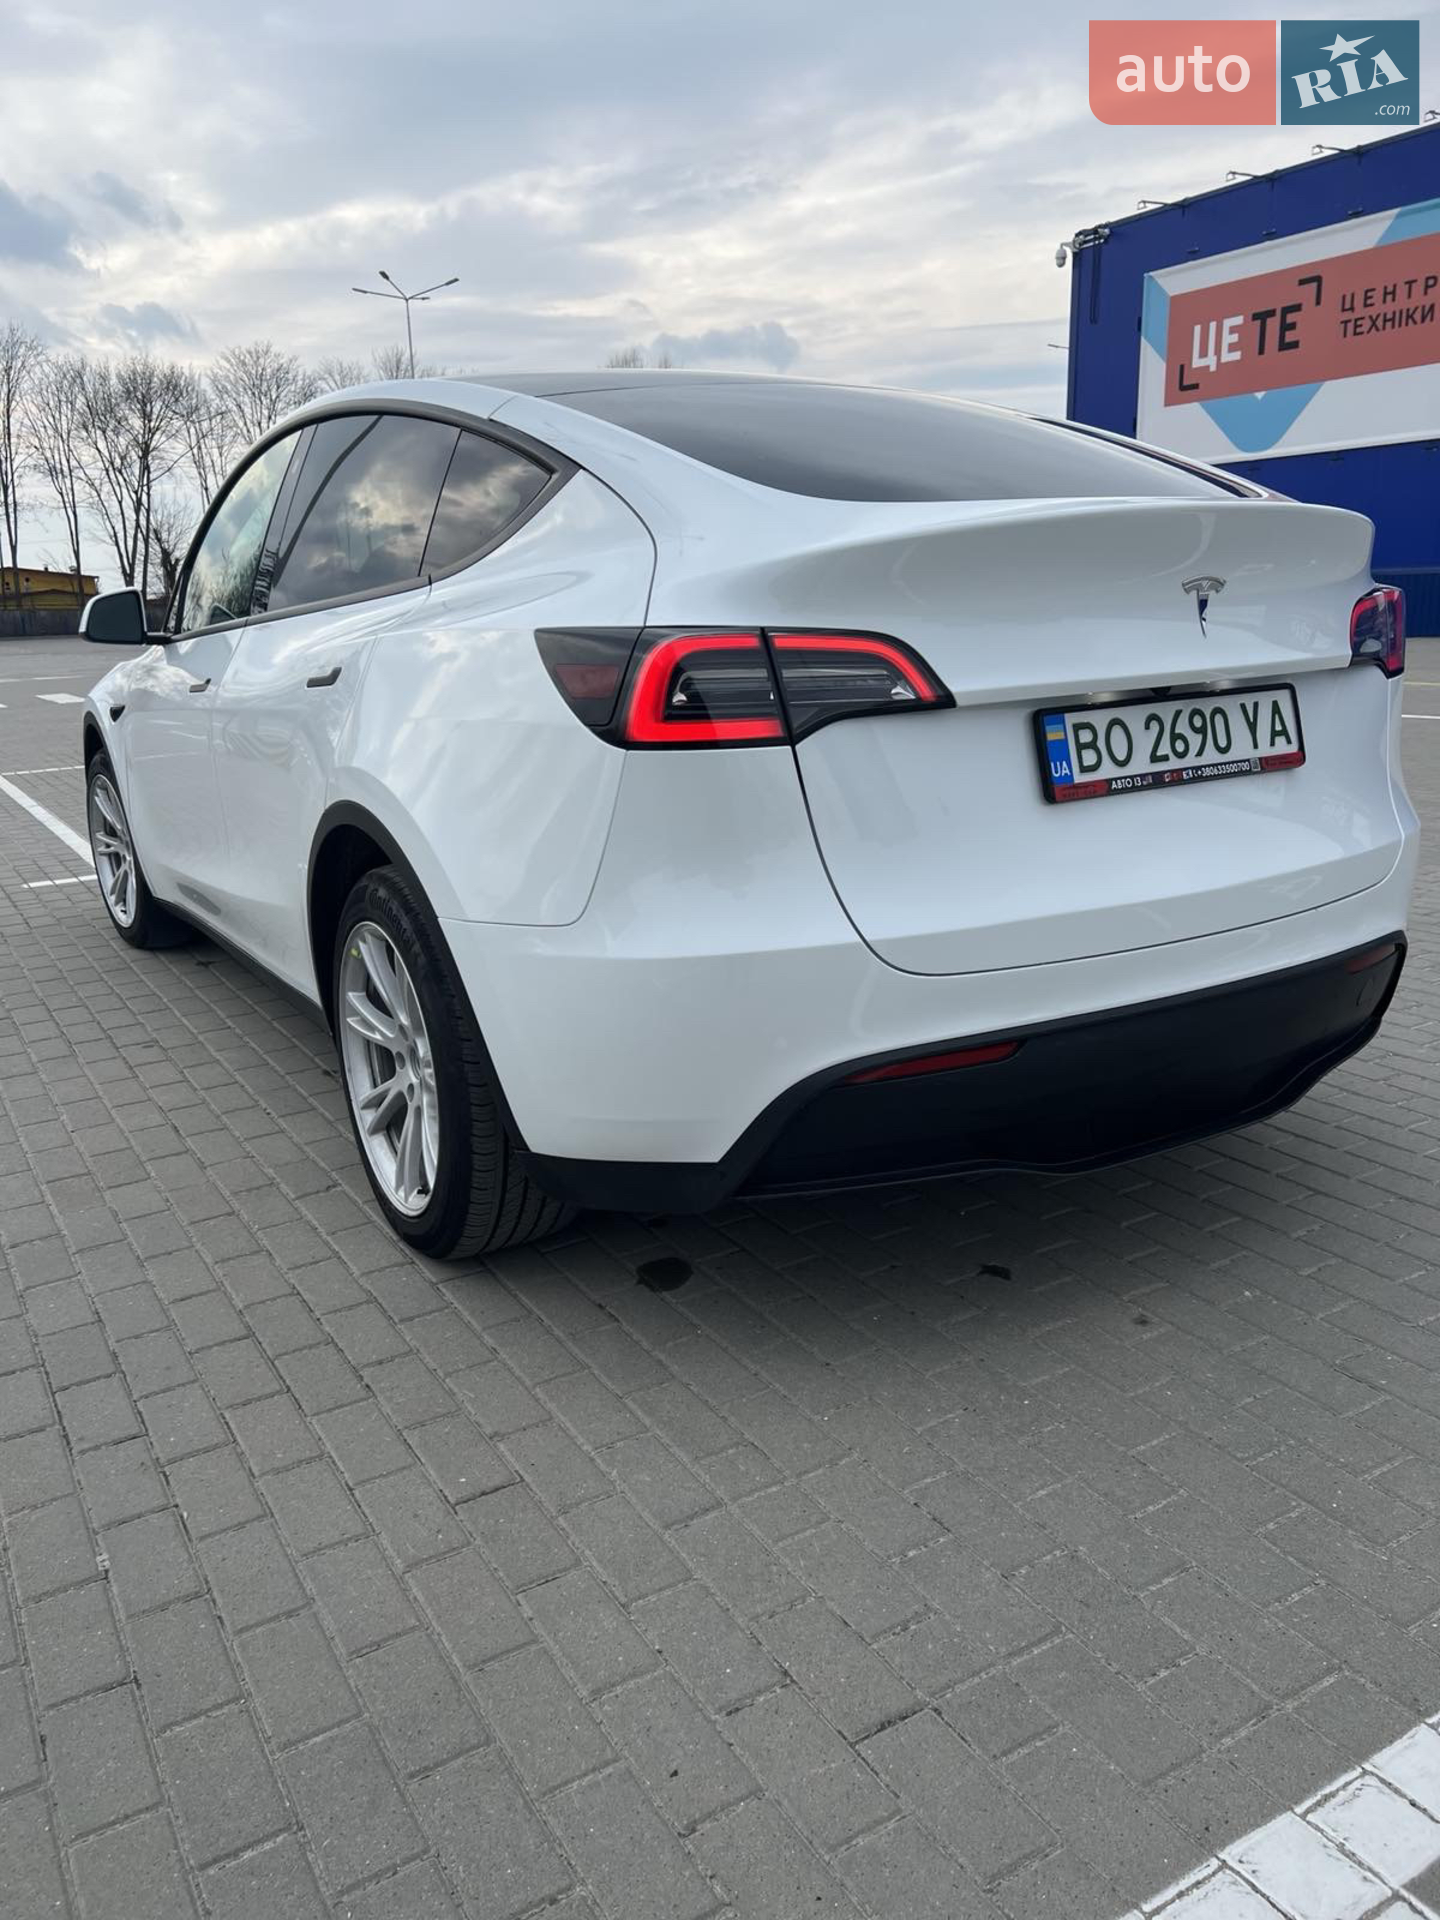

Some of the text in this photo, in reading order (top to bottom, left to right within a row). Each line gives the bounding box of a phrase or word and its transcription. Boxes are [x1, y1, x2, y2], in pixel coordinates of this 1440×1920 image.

[1340, 275, 1439, 313] ЦЕНТР
[1191, 302, 1303, 373] ЦЕТЕ
[1339, 302, 1436, 338] ТЕХНІКИ
[1072, 699, 1293, 774] BO 2690 YA
[1050, 760, 1071, 777] UA
